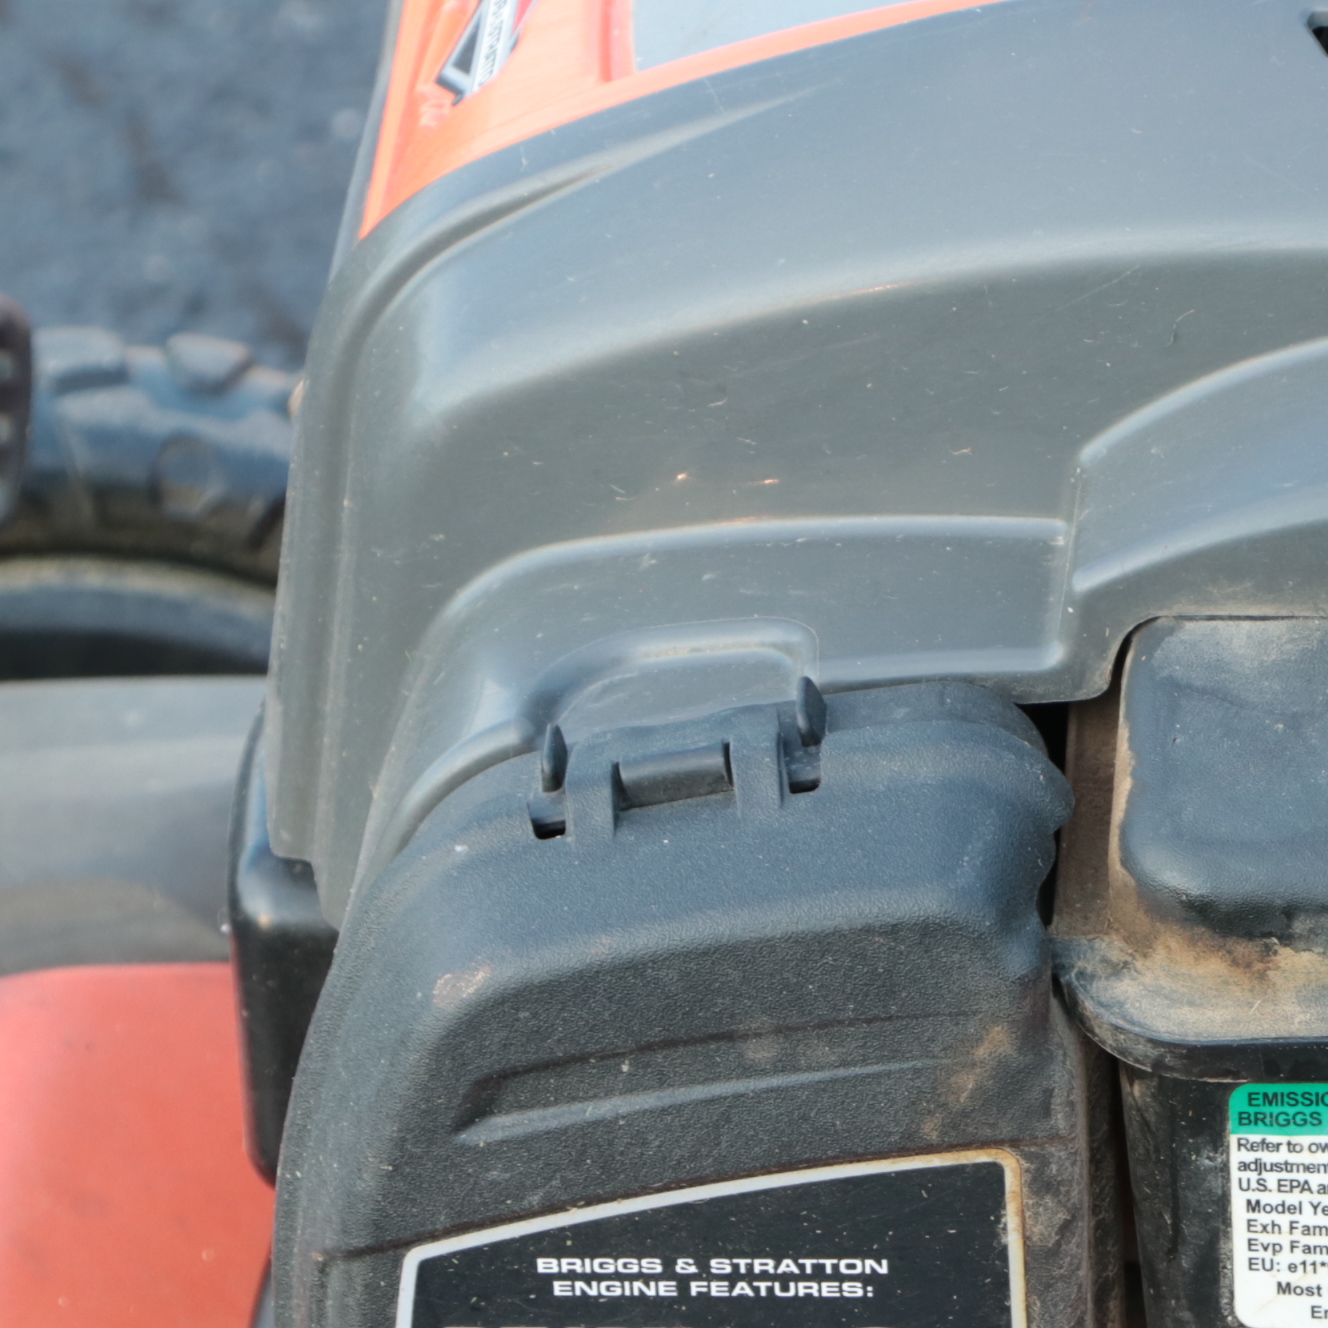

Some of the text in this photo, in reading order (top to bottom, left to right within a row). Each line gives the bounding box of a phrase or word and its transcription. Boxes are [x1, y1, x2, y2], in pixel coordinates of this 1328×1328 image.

[1238, 1111, 1322, 1127] BRIGGS
[1237, 1138, 1283, 1152] Refer
[1287, 1140, 1302, 1153] to
[1238, 1178, 1272, 1192] U.S.
[1277, 1179, 1313, 1194] EPA
[1246, 1200, 1302, 1214] Model
[1247, 1219, 1281, 1234] Exh
[1248, 1239, 1283, 1256] Evp
[536, 1258, 889, 1274] BRIGGS & STRATTON
[1248, 1258, 1281, 1272] EU:
[553, 1281, 873, 1297] ENGINE FEATURES:
[1277, 1282, 1322, 1297] Most
